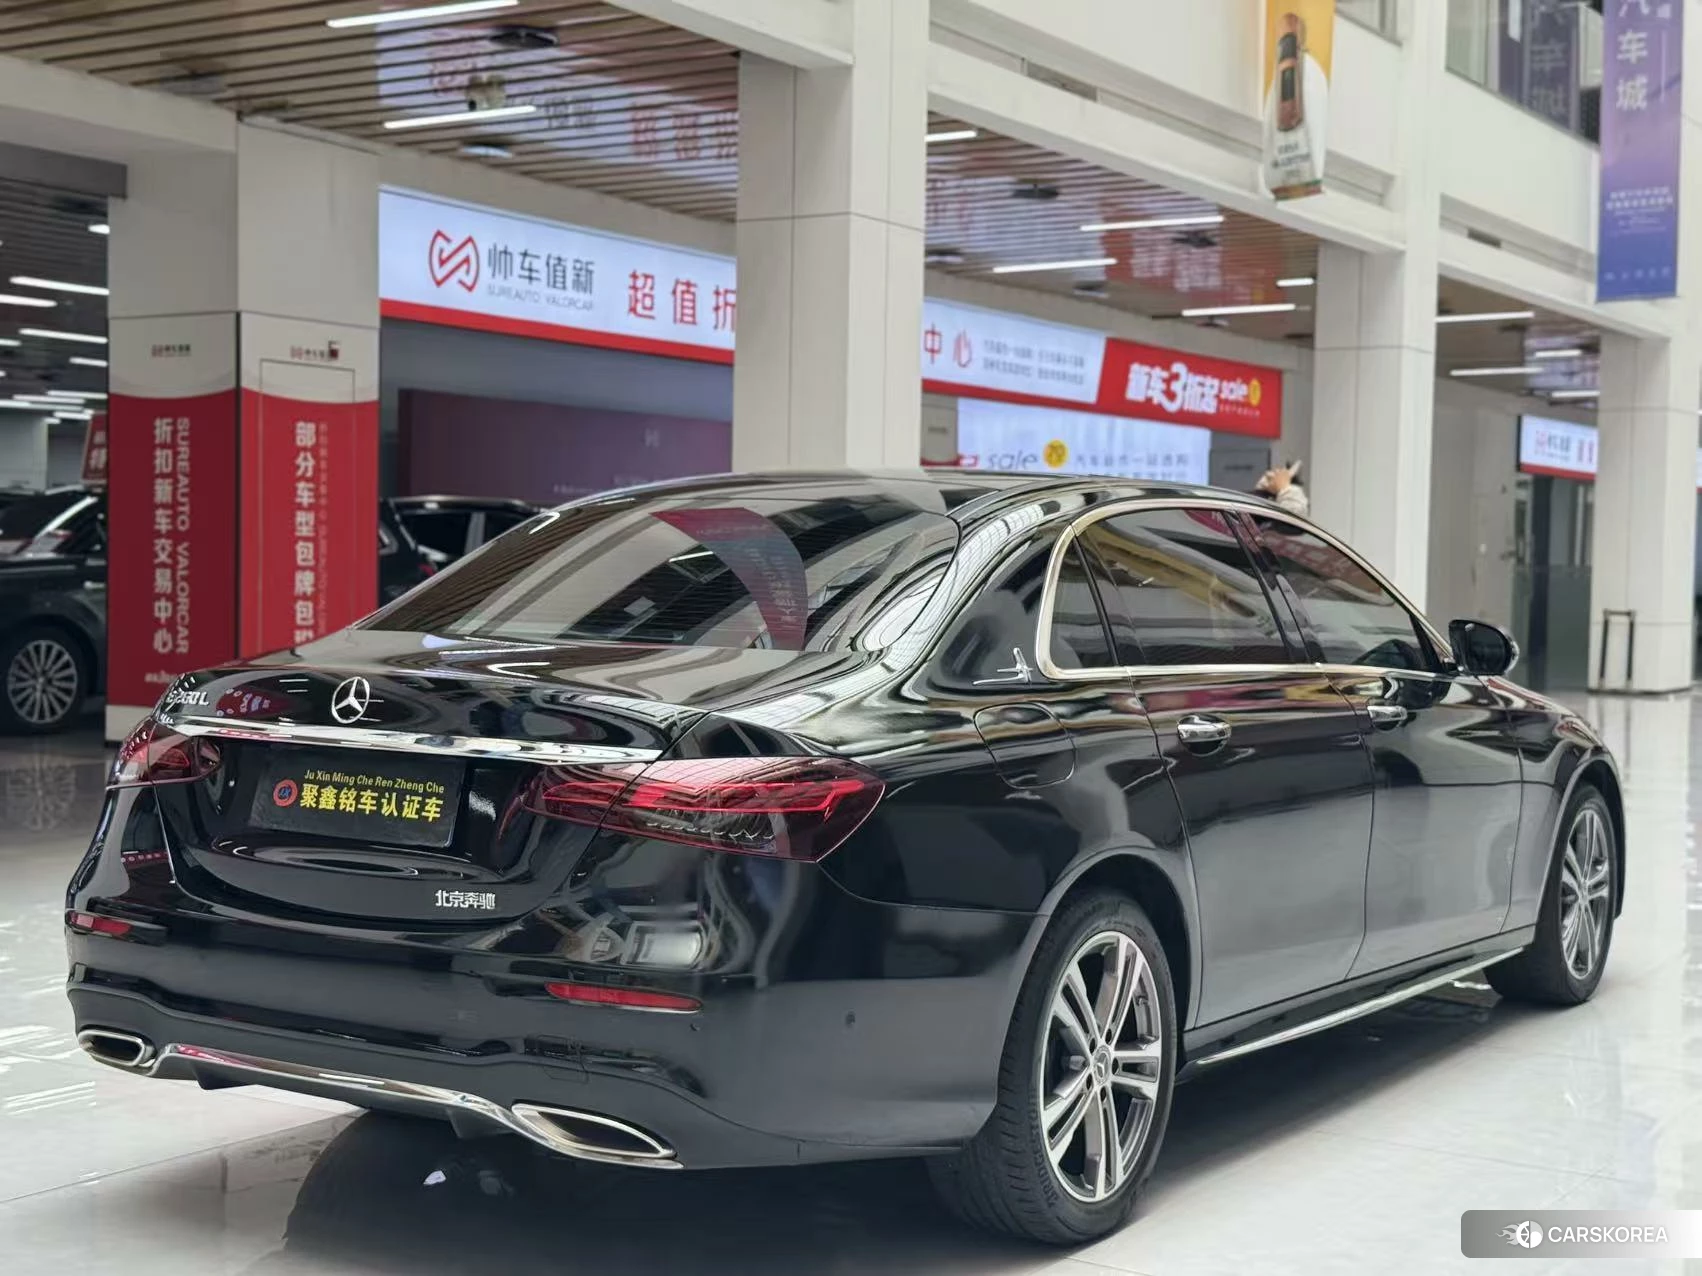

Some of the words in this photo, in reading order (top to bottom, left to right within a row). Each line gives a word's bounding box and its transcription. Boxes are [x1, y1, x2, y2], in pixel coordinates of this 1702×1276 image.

[487, 242, 596, 295] 帅车值新
[177, 417, 190, 531] SUREAUTO
[988, 450, 1038, 471] sale
[153, 417, 173, 654] 折扣新车交易中心
[176, 542, 190, 654] VALORCAR
[300, 782, 444, 823] 聚鑫铭车认证车
[304, 769, 315, 780] Ju
[316, 770, 331, 782] Xin
[332, 771, 355, 786] Ming
[356, 774, 373, 786] Che
[375, 776, 393, 788] Ren
[394, 778, 424, 793] Zheng
[426, 781, 445, 794] Che
[434, 889, 496, 910] 北京奔驰
